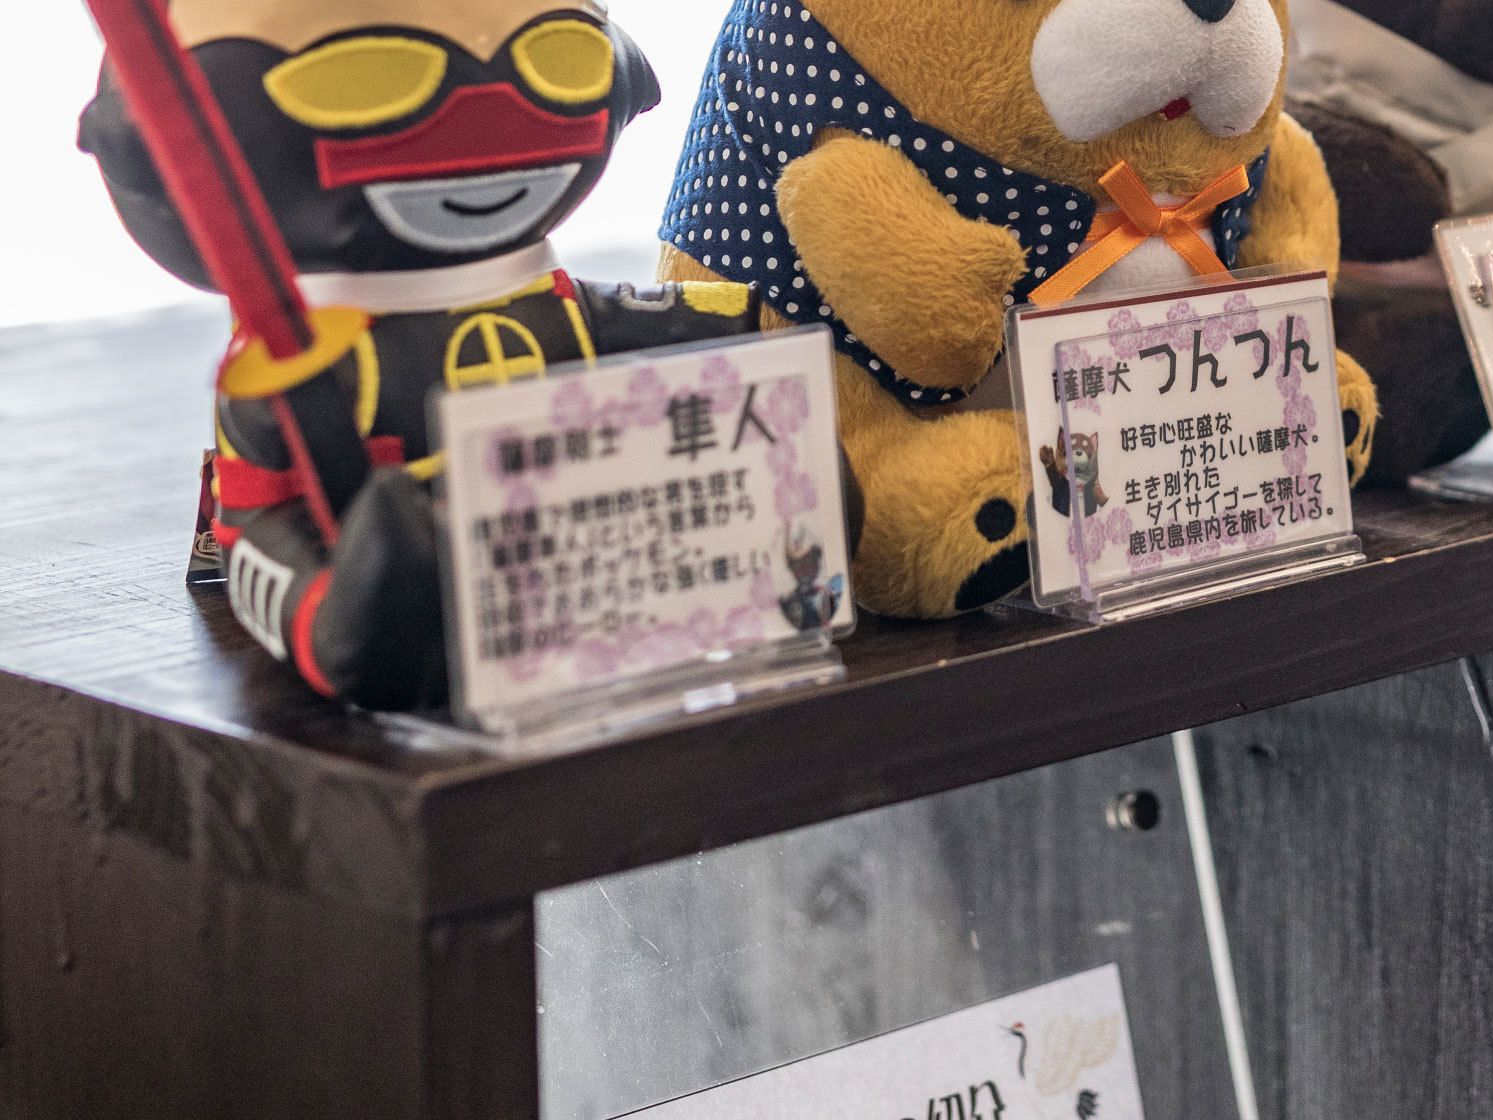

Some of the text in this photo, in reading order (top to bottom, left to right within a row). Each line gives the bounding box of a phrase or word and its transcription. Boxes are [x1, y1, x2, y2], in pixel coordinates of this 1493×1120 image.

[1052, 314, 1320, 403] 薩摩犬 つんつん
[664, 382, 777, 464] 隼人
[1120, 412, 1234, 452] 好奇心旺盛な
[1180, 424, 1319, 468] かわいい薩摩犬。
[1125, 465, 1221, 505] 生き別れた
[1146, 472, 1323, 525] ダイサイゴーを探して
[1129, 497, 1334, 556] 鹿児島県内を旅している。
